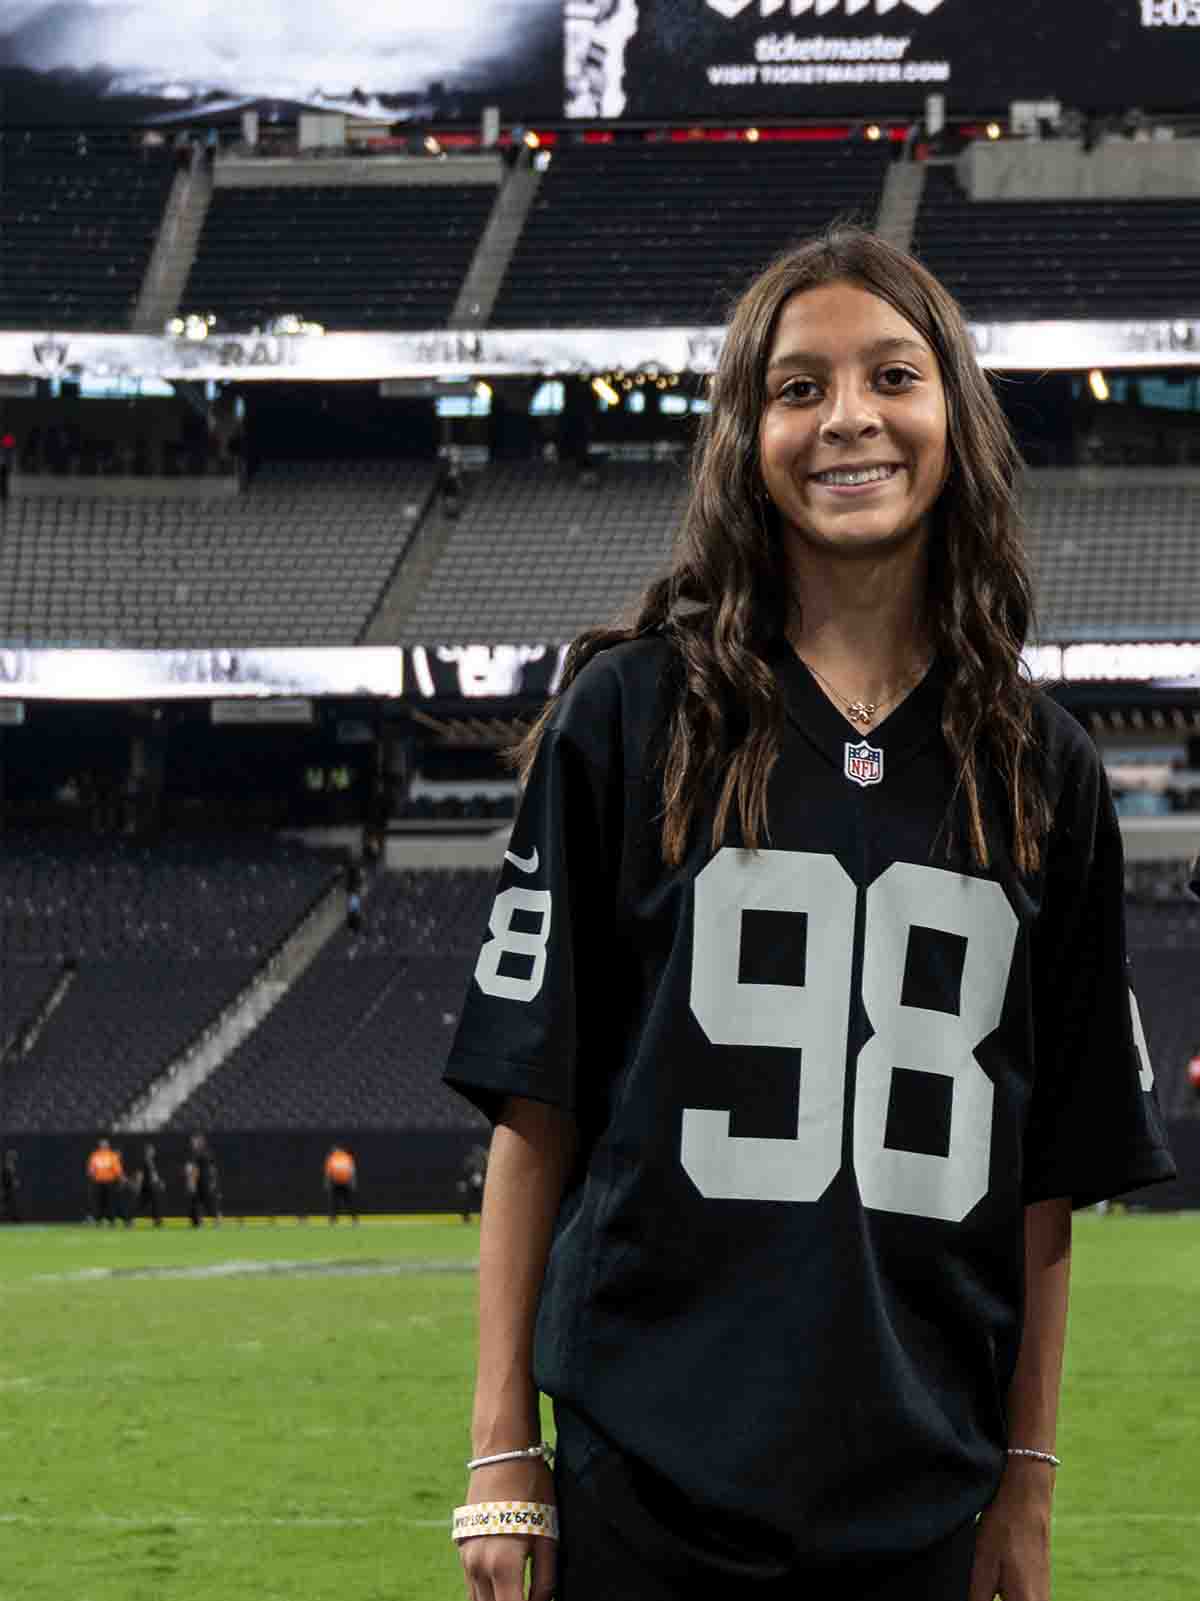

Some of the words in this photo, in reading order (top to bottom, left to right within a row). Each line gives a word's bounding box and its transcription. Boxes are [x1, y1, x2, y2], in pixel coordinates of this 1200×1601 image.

[755, 34, 911, 62] ticketmaster
[706, 64, 757, 84] VISIT
[759, 61, 950, 84] TICKETMASTER.COM
[848, 758, 881, 779] NFL
[680, 847, 1019, 1222] 98
[499, 1511, 544, 1527] 09.29.24
